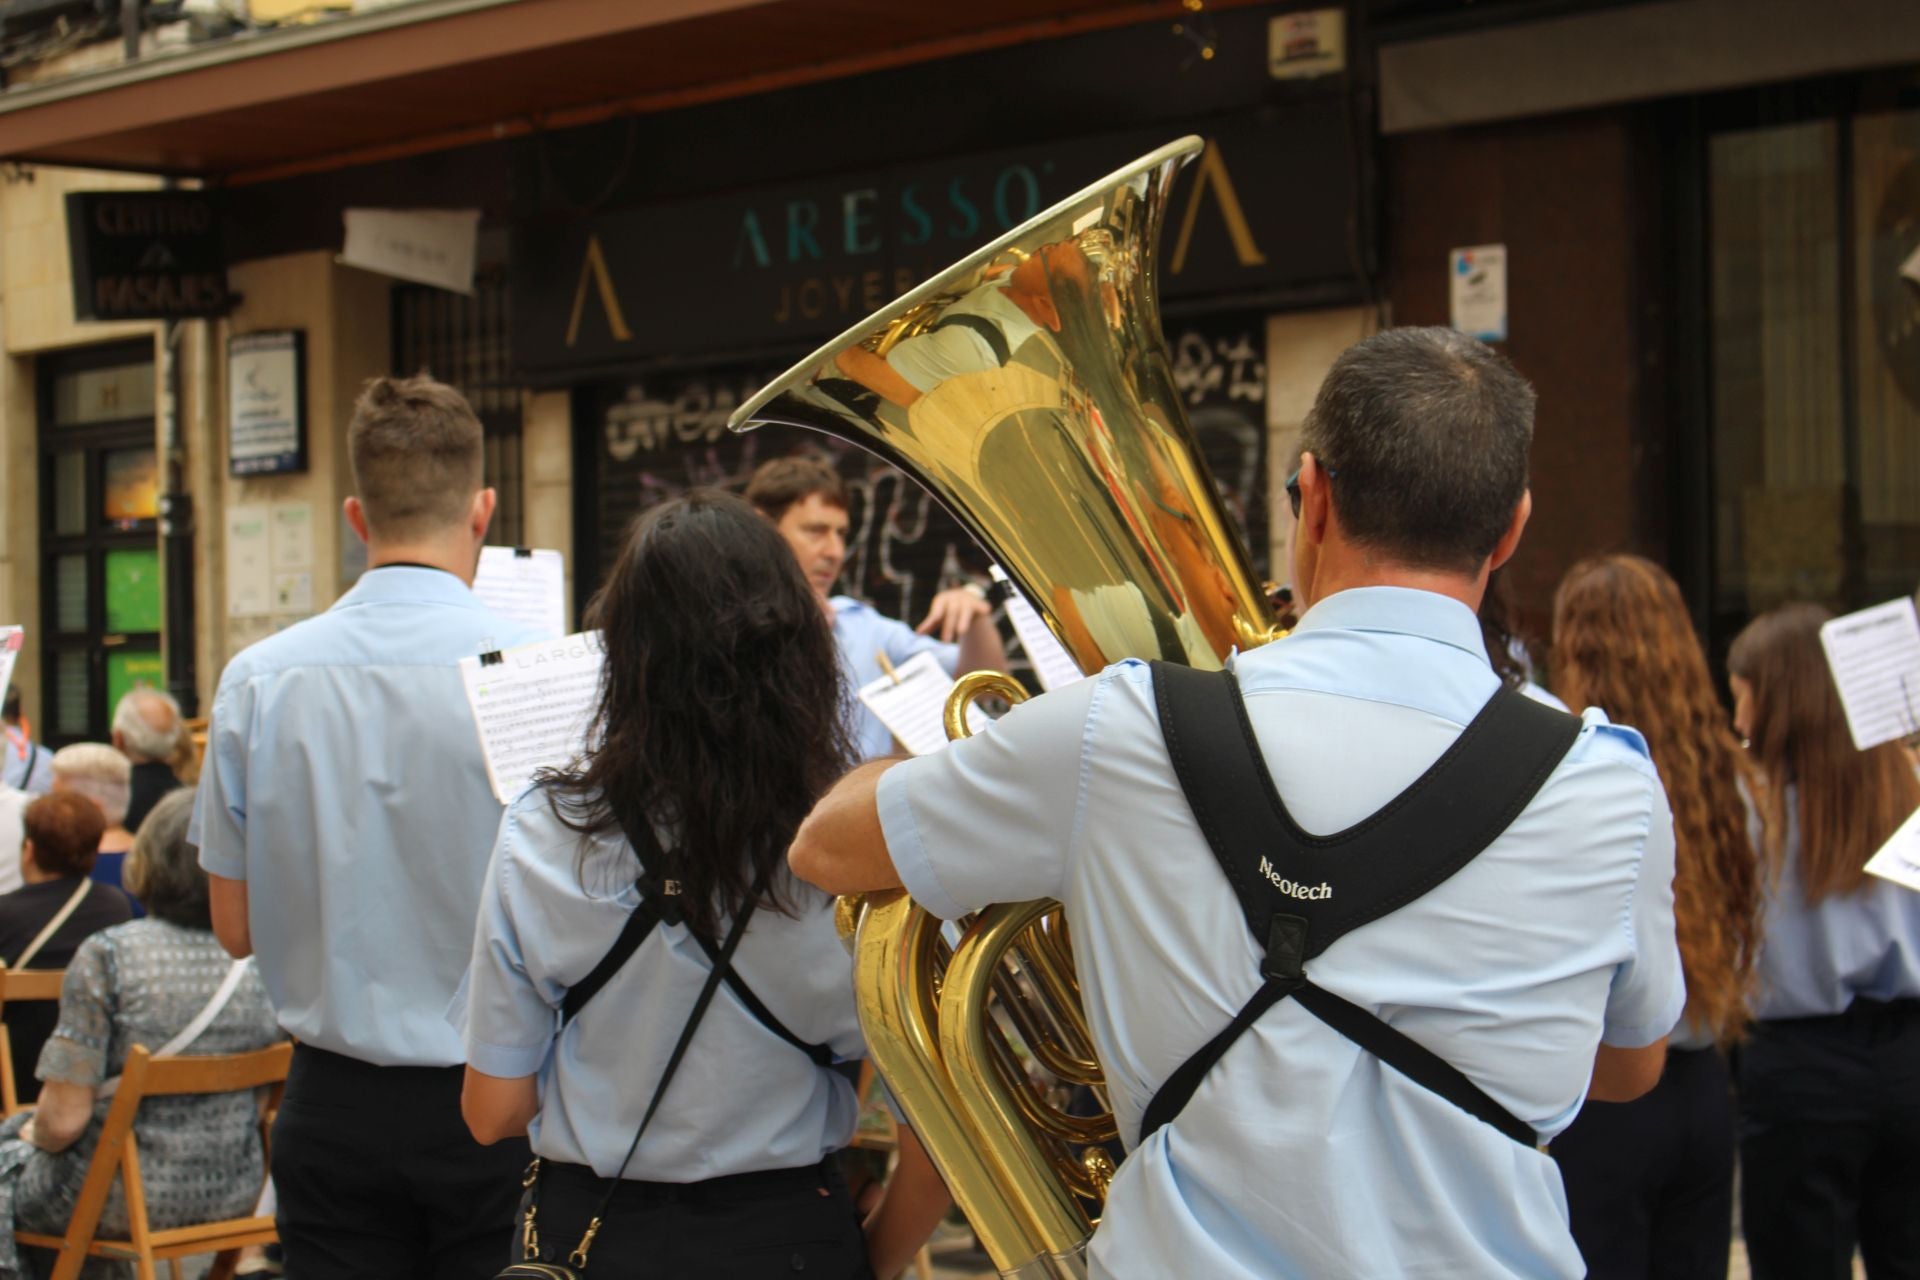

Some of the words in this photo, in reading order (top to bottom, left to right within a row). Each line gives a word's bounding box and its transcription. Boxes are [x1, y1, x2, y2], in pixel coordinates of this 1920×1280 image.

[95, 200, 209, 237] CENTRO
[733, 164, 1041, 268] ARESSO
[775, 265, 920, 321] JOYER
[1259, 855, 1332, 900] Neotech
